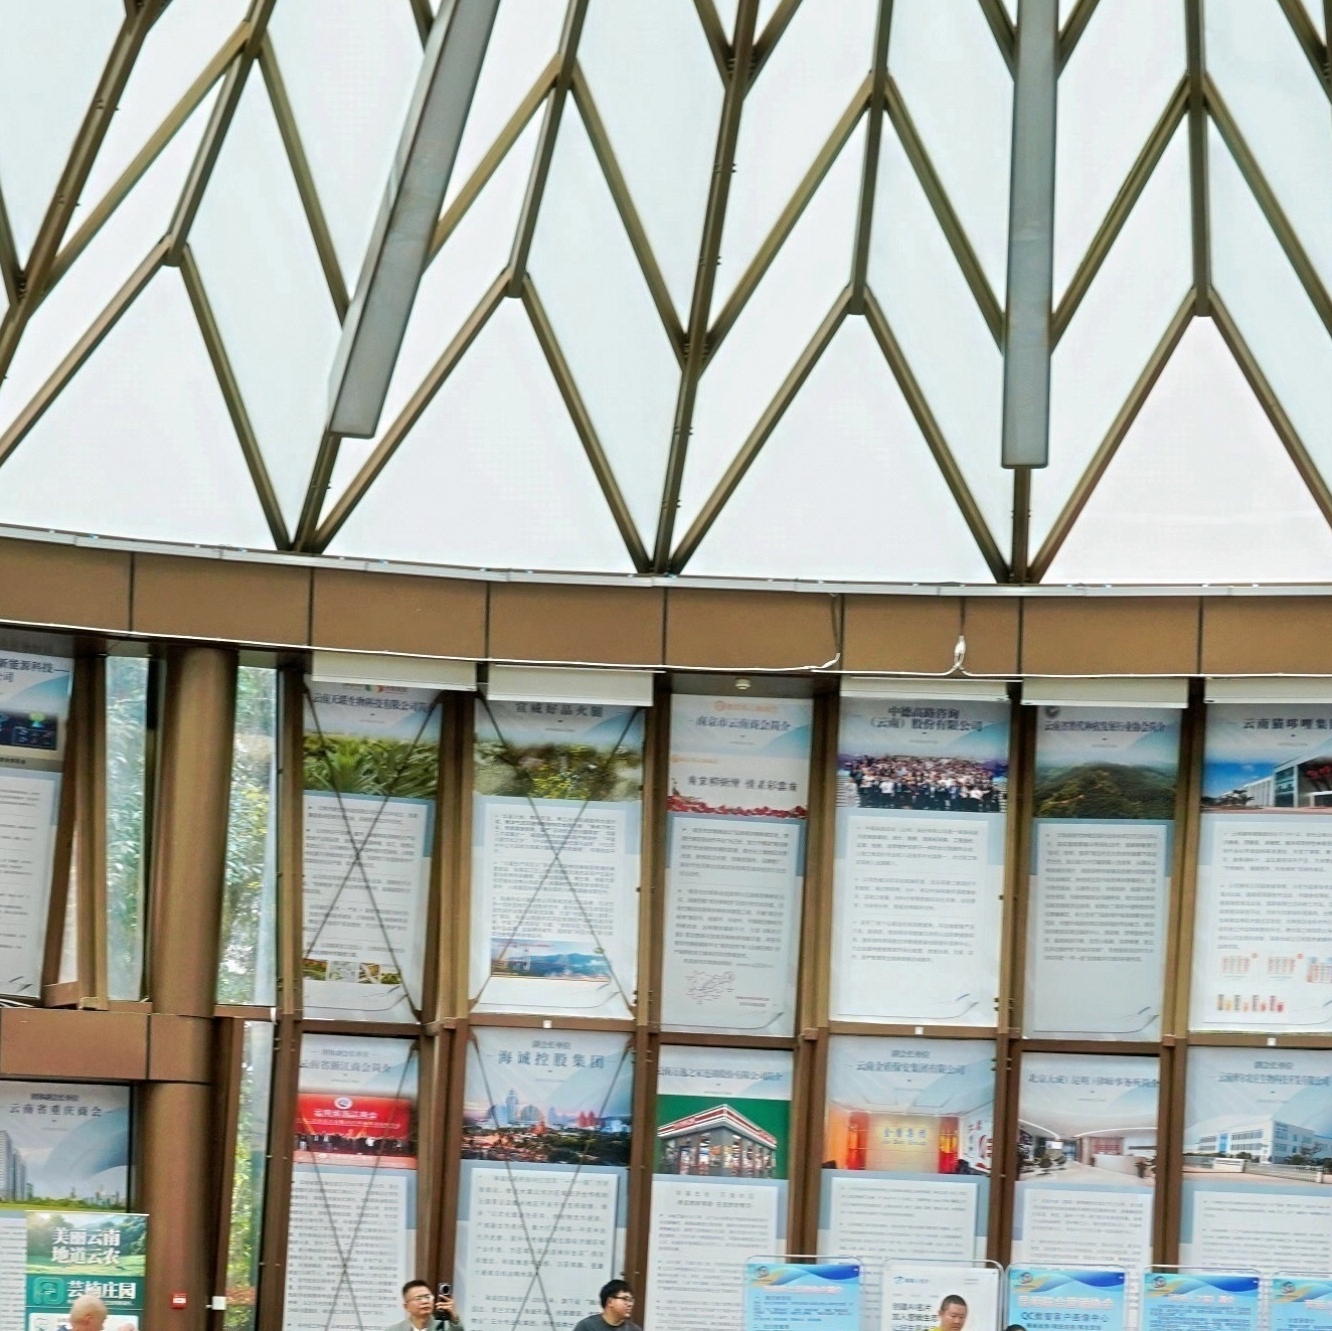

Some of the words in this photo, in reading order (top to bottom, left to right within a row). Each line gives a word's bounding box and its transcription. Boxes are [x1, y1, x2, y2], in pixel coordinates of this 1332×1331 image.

[498, 1050, 604, 1069] 海诚控股集团
[10, 1104, 102, 1117] 云南省重庆商会
[52, 1227, 121, 1246] 美丽云南
[51, 1246, 121, 1265] 地道云农
